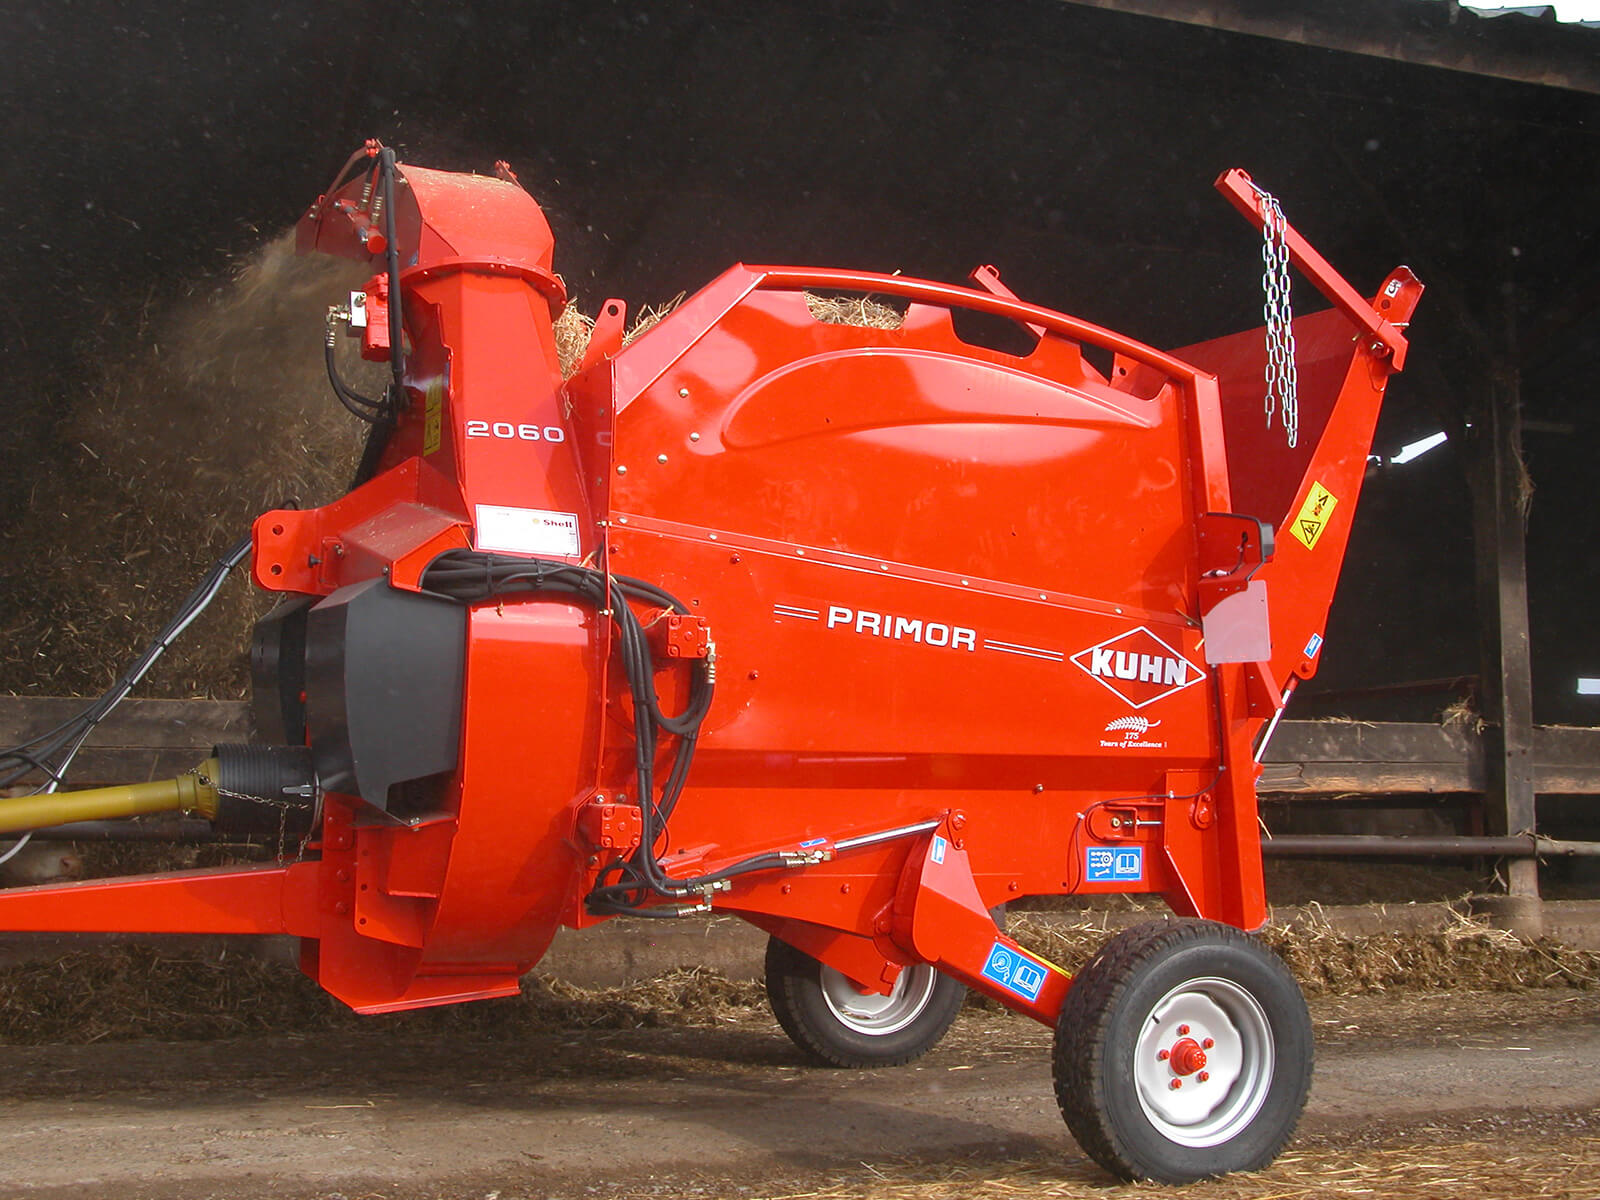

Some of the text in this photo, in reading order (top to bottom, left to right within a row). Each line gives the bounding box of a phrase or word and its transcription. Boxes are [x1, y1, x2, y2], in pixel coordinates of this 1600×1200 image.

[467, 420, 565, 443] 2060
[543, 519, 573, 529] Shell
[827, 605, 977, 652] PRIMOR
[1091, 647, 1187, 687] KUHN
[1124, 732, 1139, 740] 175
[1119, 740, 1127, 749] of
